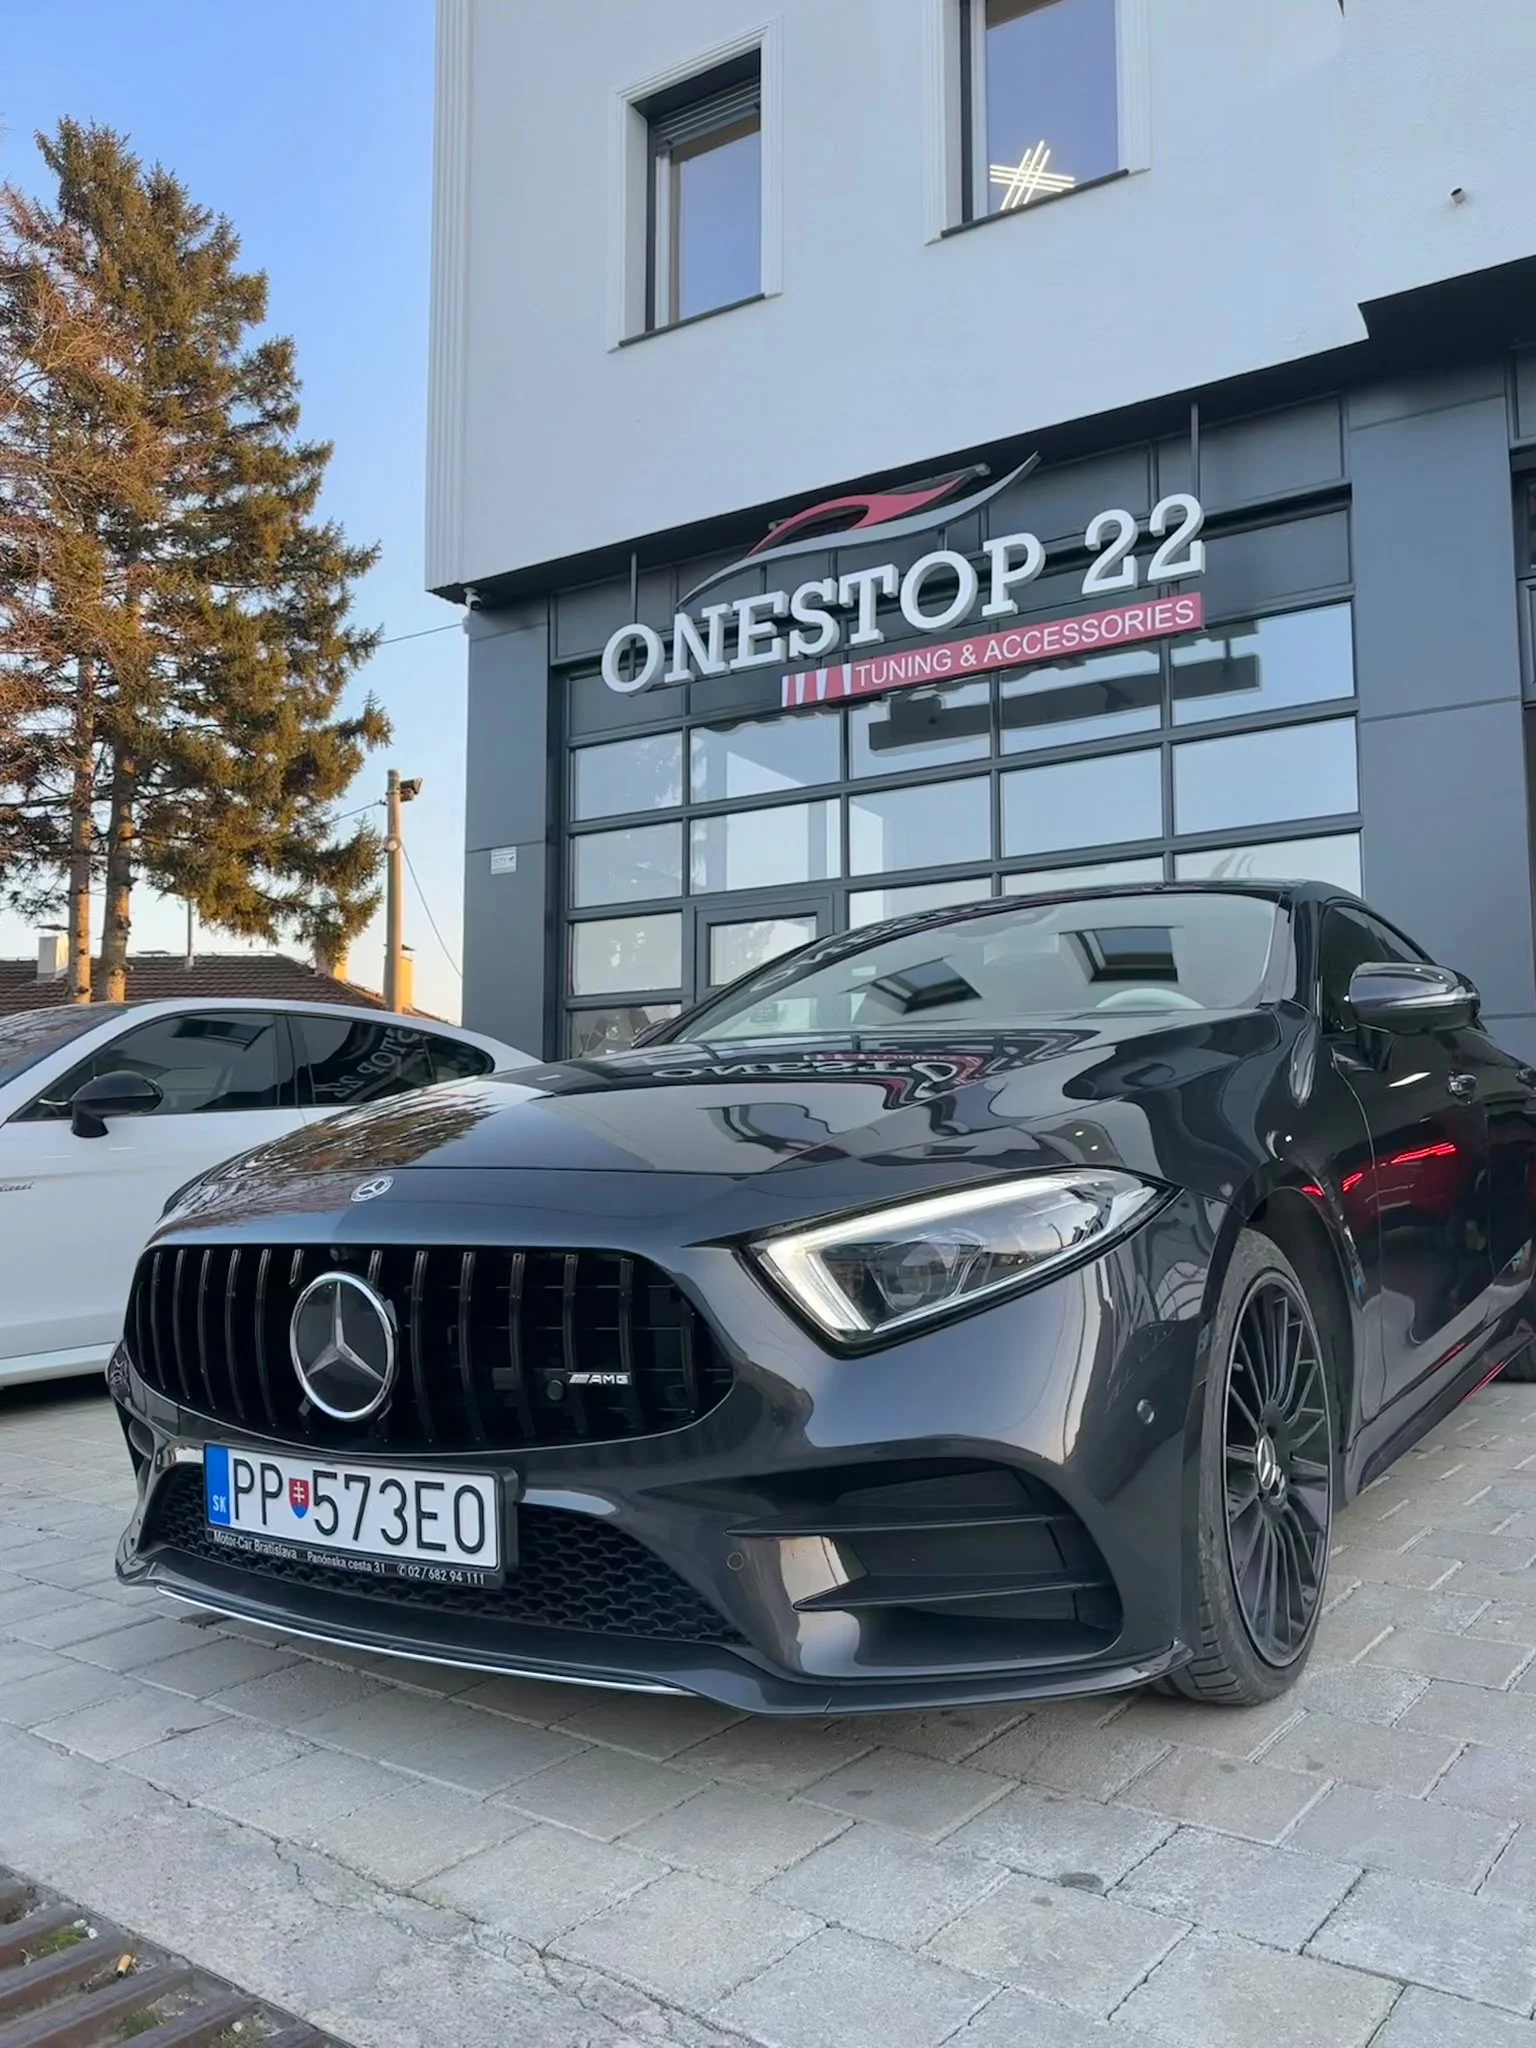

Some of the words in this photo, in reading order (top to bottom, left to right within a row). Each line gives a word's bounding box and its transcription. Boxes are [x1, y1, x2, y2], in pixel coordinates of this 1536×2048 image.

[602, 532, 1046, 694] ONESTOP
[1081, 493, 1206, 596] 22
[855, 649, 952, 687] TUNING
[960, 645, 978, 666] &
[983, 600, 1195, 664] ACCESSORIES
[588, 1374, 629, 1385] AMG
[212, 1494, 227, 1513] SK
[232, 1458, 284, 1527] PP
[254, 1539, 298, 1560] Bratislava
[347, 1560, 373, 1573] cesta
[373, 1561, 386, 1574] 31
[449, 1571, 463, 1583] 94
[466, 1573, 485, 1585] 111
